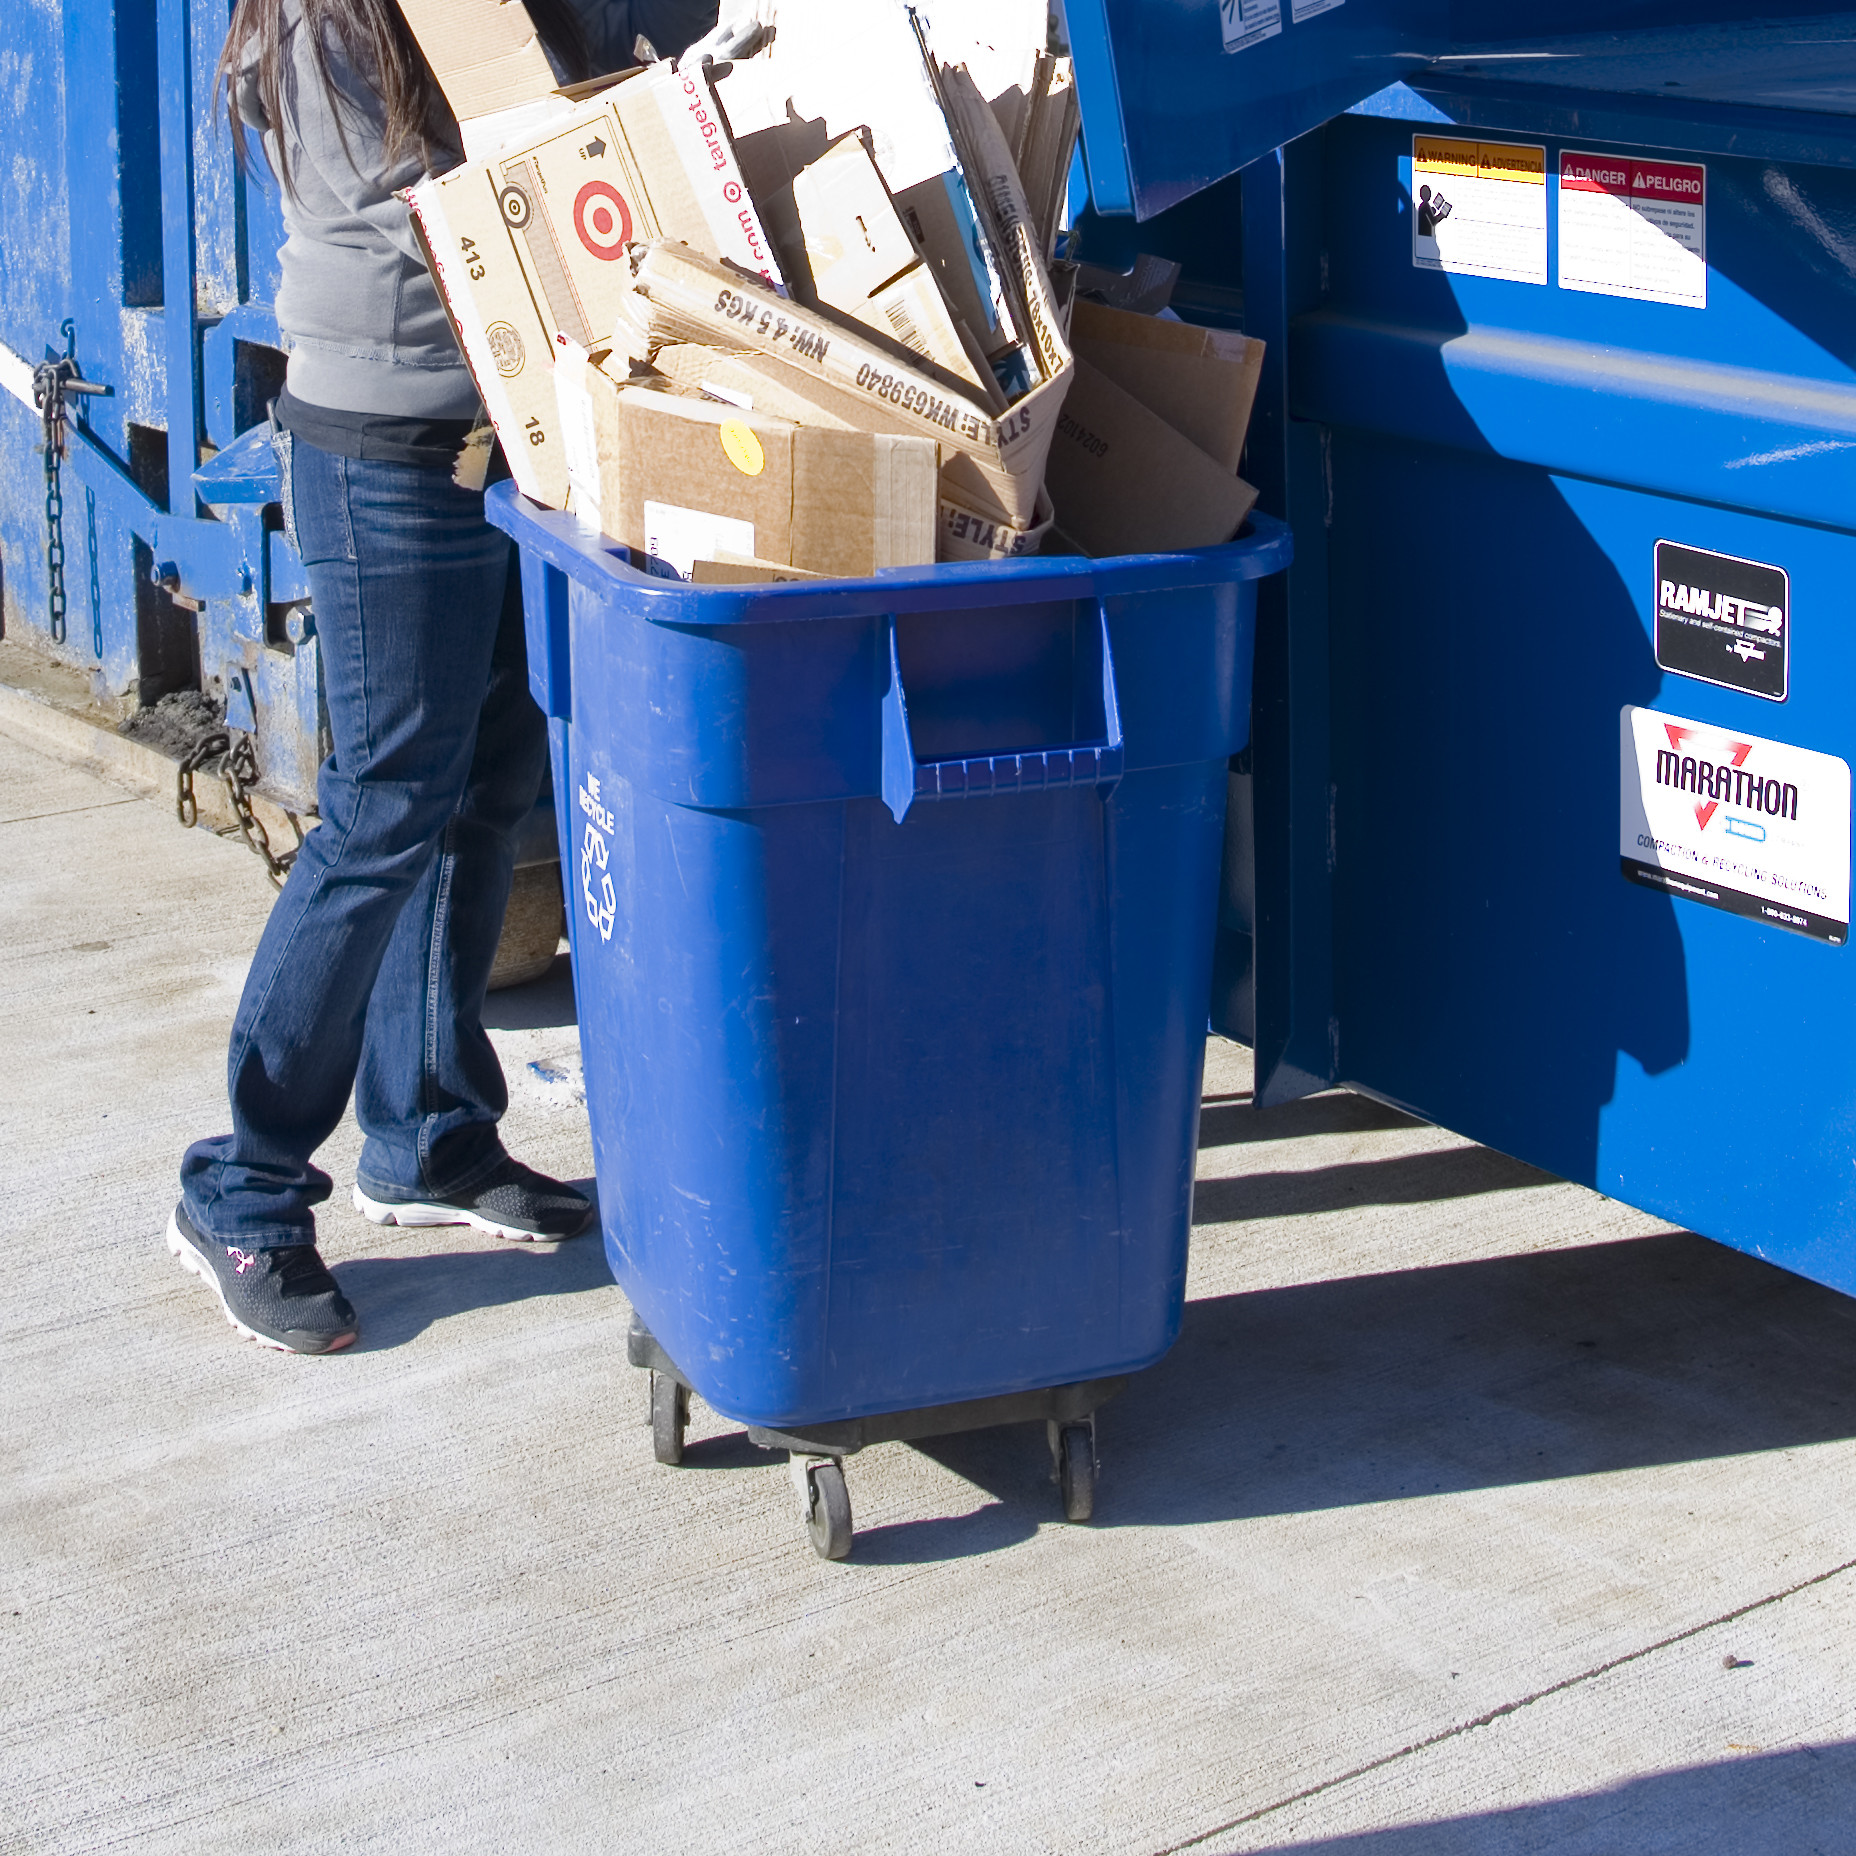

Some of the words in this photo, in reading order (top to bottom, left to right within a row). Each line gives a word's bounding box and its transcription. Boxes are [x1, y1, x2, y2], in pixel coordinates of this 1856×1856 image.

[1428, 150, 1476, 166] WARNING
[1492, 157, 1543, 173] ADVERTENCIA
[1575, 167, 1626, 185] DANGER
[1646, 175, 1701, 194] PELIGRO
[460, 235, 485, 281] 413
[714, 289, 758, 326] KGS
[525, 416, 545, 446] 18
[1659, 579, 1747, 627] RAMJET
[587, 771, 601, 802] WE
[1656, 749, 1798, 821] MARATHON
[579, 784, 615, 835] RECYCLE
[1637, 834, 1698, 862] COMPACTION
[1712, 855, 1768, 882] RECYCLING
[1771, 873, 1827, 900] SOLUTIONS
